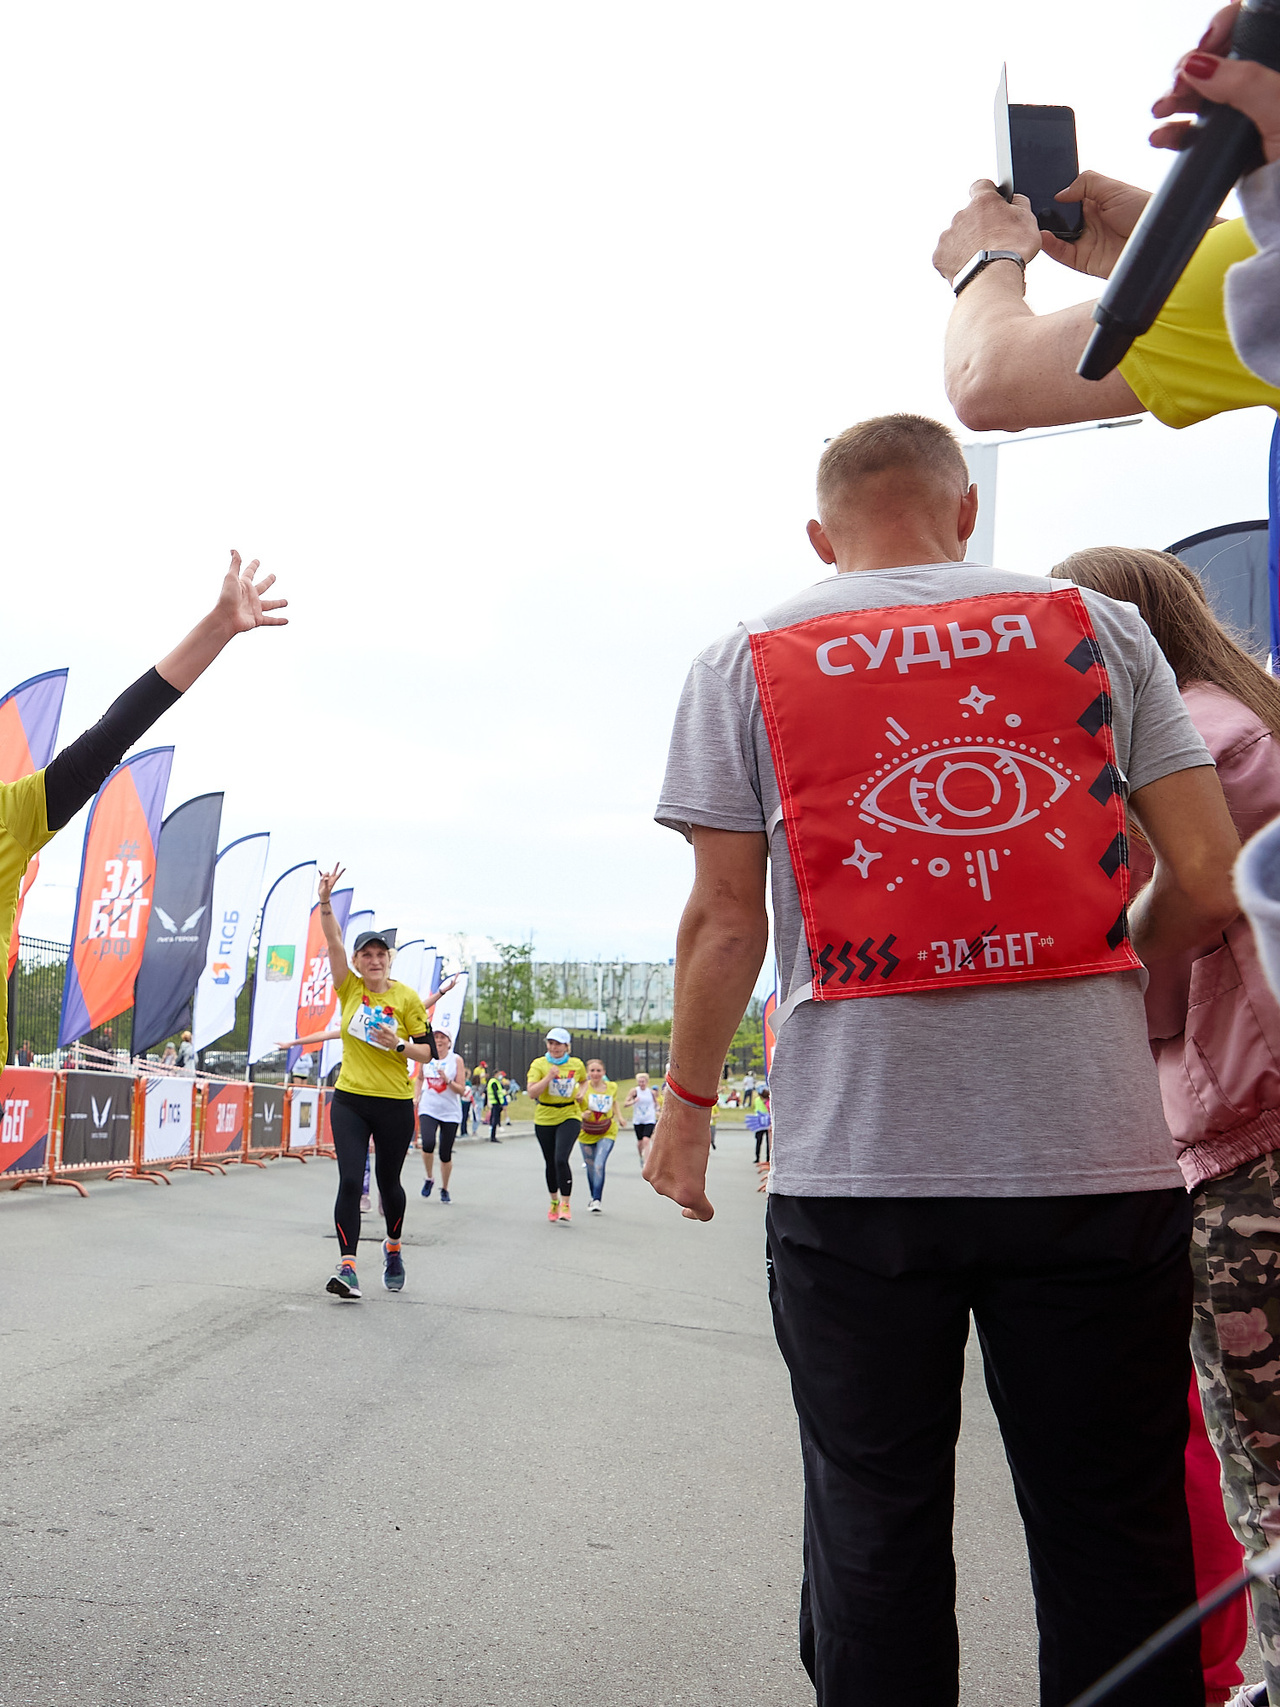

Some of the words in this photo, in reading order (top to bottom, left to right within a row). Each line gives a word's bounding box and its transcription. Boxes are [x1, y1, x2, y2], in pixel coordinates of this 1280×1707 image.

[816, 614, 1037, 676] СУДЬЯ
[101, 859, 143, 899] ЗА
[88, 898, 150, 940] БЕГ
[218, 910, 240, 955] ПСБ
[169, 1104, 181, 1124] ПСБ
